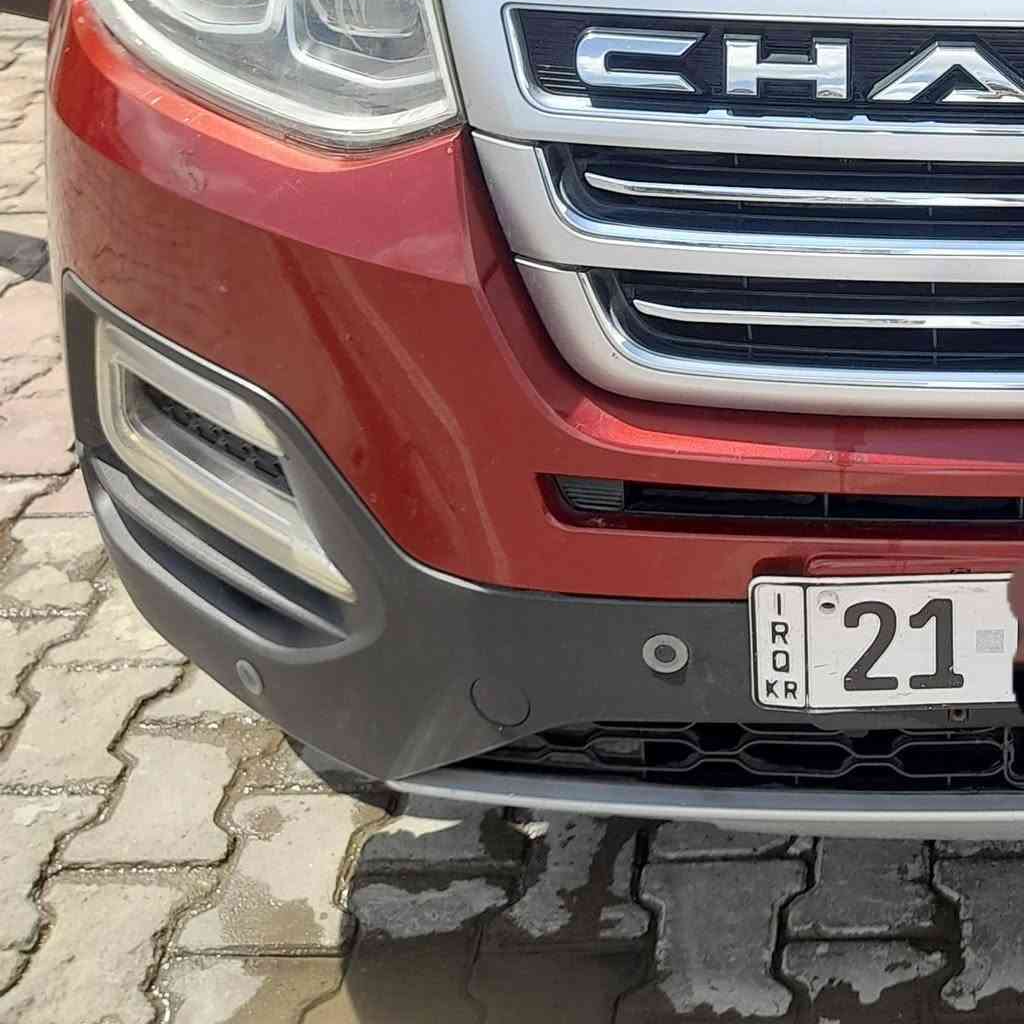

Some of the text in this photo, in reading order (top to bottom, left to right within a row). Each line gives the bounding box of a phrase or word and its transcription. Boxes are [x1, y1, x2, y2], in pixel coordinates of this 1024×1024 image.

[770, 592, 790, 674] IRQ
[843, 597, 965, 692] 21
[765, 679, 798, 701] KR
